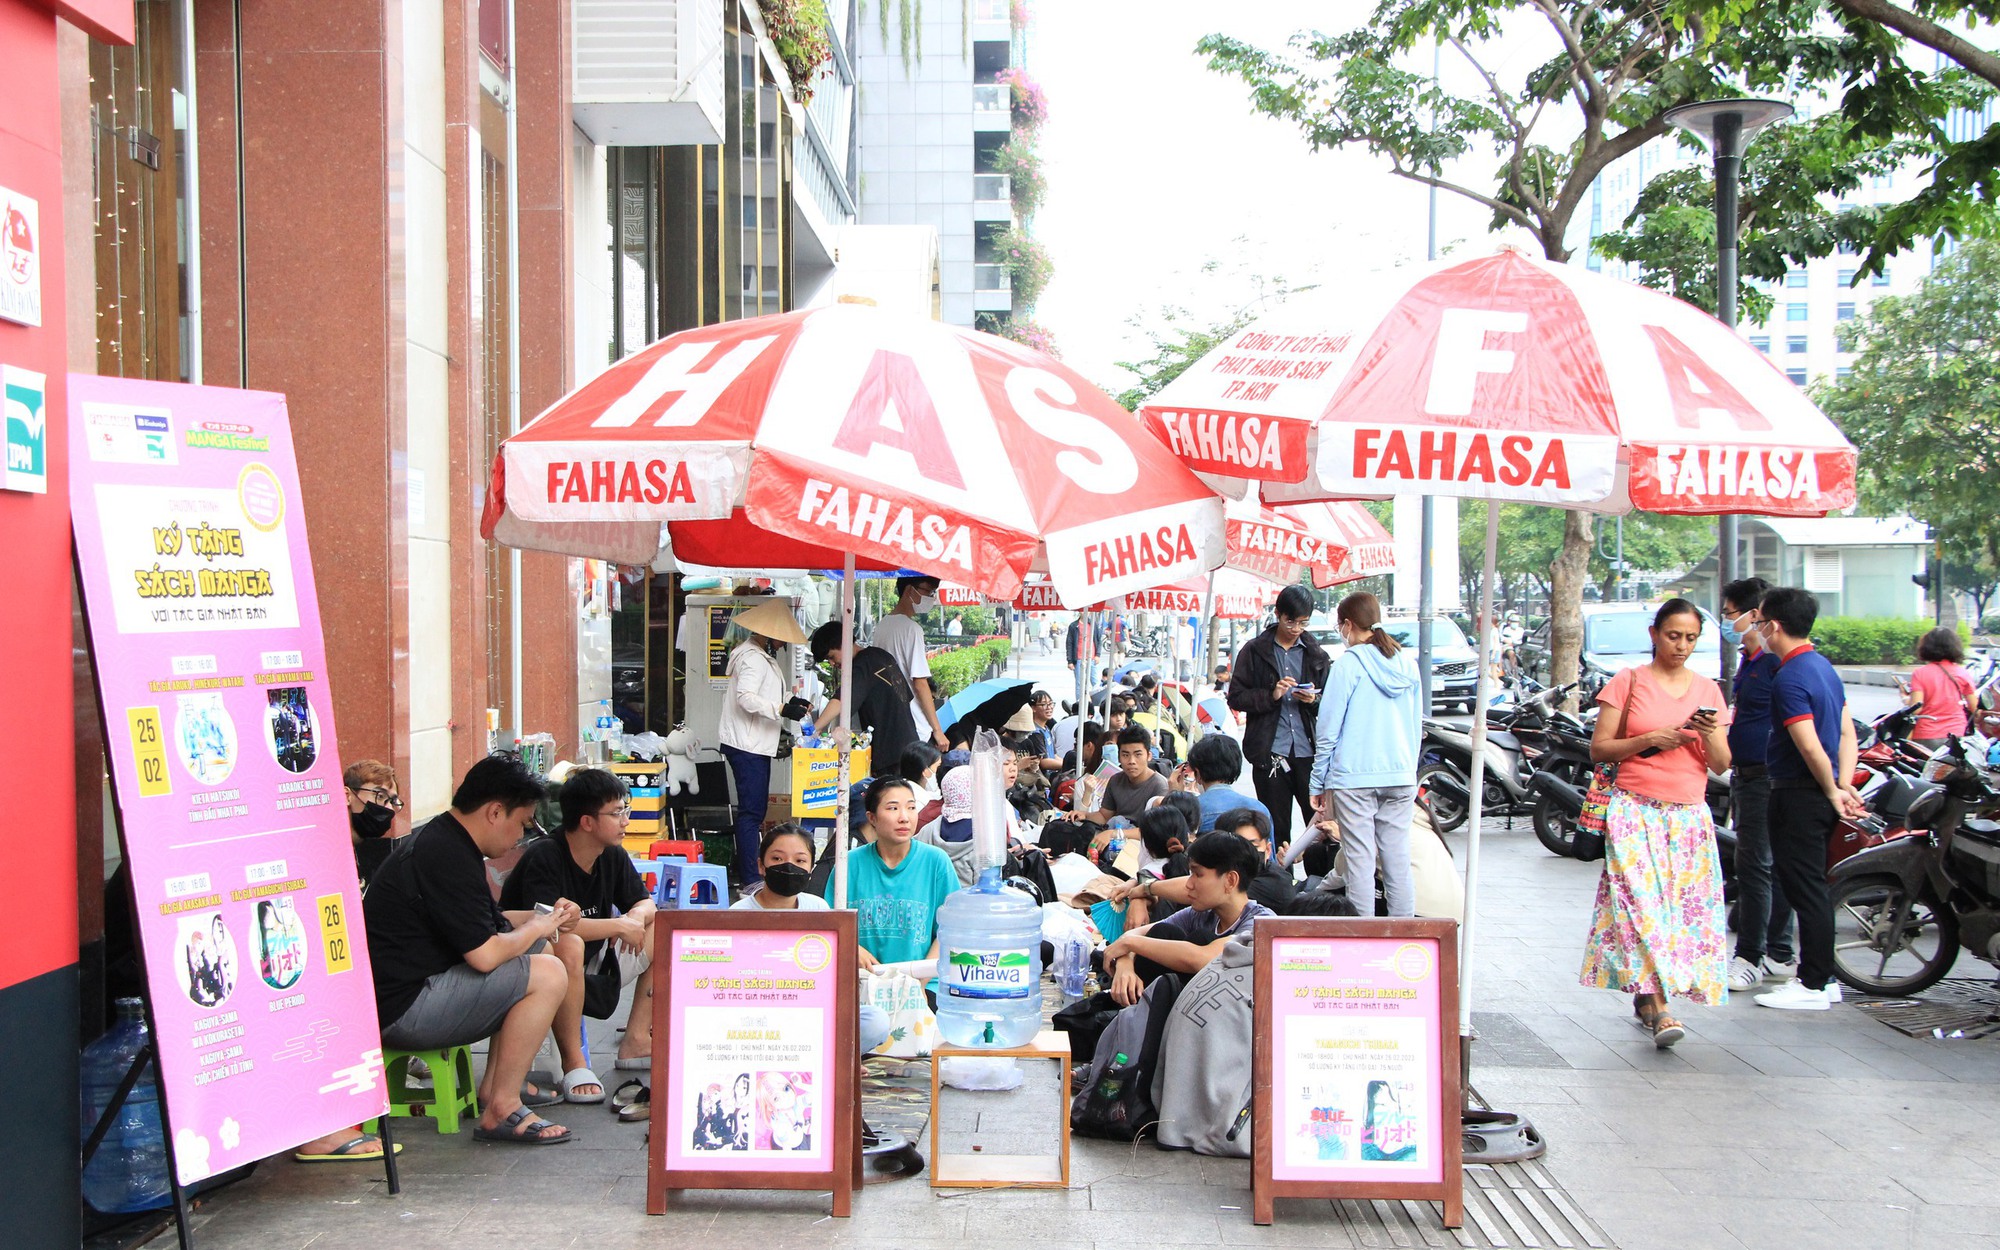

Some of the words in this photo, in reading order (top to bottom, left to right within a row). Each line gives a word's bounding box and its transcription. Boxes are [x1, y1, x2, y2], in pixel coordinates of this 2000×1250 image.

[1235, 330, 1280, 351] CÔNG
[1273, 336, 1299, 352] TY
[1211, 354, 1256, 375] PHÁT
[1246, 355, 1294, 377] HÀNH
[1286, 357, 1332, 380] SÁCH
[1423, 308, 1529, 415] F
[590, 334, 783, 427] H
[1640, 324, 1773, 431] A
[1221, 380, 1280, 401] TP.HCM
[832, 349, 967, 491] A
[1004, 367, 1139, 494] S
[186, 430, 230, 449] MANGA
[230, 434, 270, 452] Festival
[1161, 412, 1284, 472] FAHASA
[1353, 429, 1571, 490] FAHASA
[547, 460, 697, 505] FAHASA
[1657, 444, 1821, 500] FAHASA
[797, 477, 974, 571] FAHASA
[153, 520, 183, 557] KÝ
[186, 521, 244, 562] TẶNG
[1239, 523, 1328, 564] FAHASA
[1084, 523, 1196, 586] FAHASA
[1359, 546, 1396, 570] FAHASA
[135, 562, 196, 598] SÁCH
[198, 568, 274, 598] MANGA
[946, 588, 982, 603] FAHAS
[1022, 587, 1064, 607] FAH
[1125, 591, 1200, 612] FAHASA
[137, 718, 156, 743] 25
[143, 757, 162, 782] 02
[278, 780, 305, 794] KARAOKE
[191, 793, 210, 805] KIETA
[234, 804, 249, 817] PHAI
[295, 794, 322, 808] KARAOKE
[159, 902, 172, 916] TÁC
[183, 896, 210, 912] AKASAKA
[210, 894, 223, 907] AKA
[324, 904, 340, 927] 26
[330, 939, 345, 962] 02
[694, 976, 709, 989] KÝ
[711, 976, 741, 992] TẶNG
[744, 976, 773, 989] SÁCH
[775, 978, 815, 990] MANGA
[959, 964, 1020, 983] Vihawa
[1294, 984, 1309, 998] KÝ
[1312, 985, 1342, 1000] TẶNG
[1344, 985, 1374, 999] SÁCH
[1376, 987, 1417, 1000] MANGA
[269, 999, 284, 1013] BLUE
[194, 1010, 238, 1032] KAGUYA-SAMA
[726, 1029, 763, 1040] AKASAKA
[764, 1029, 781, 1040] AKA
[200, 1044, 244, 1067] KAGUYA-SAMA
[1302, 1086, 1310, 1094] 11
[1310, 1109, 1351, 1122] BLUE
[1301, 1123, 1352, 1138] PERIOD
